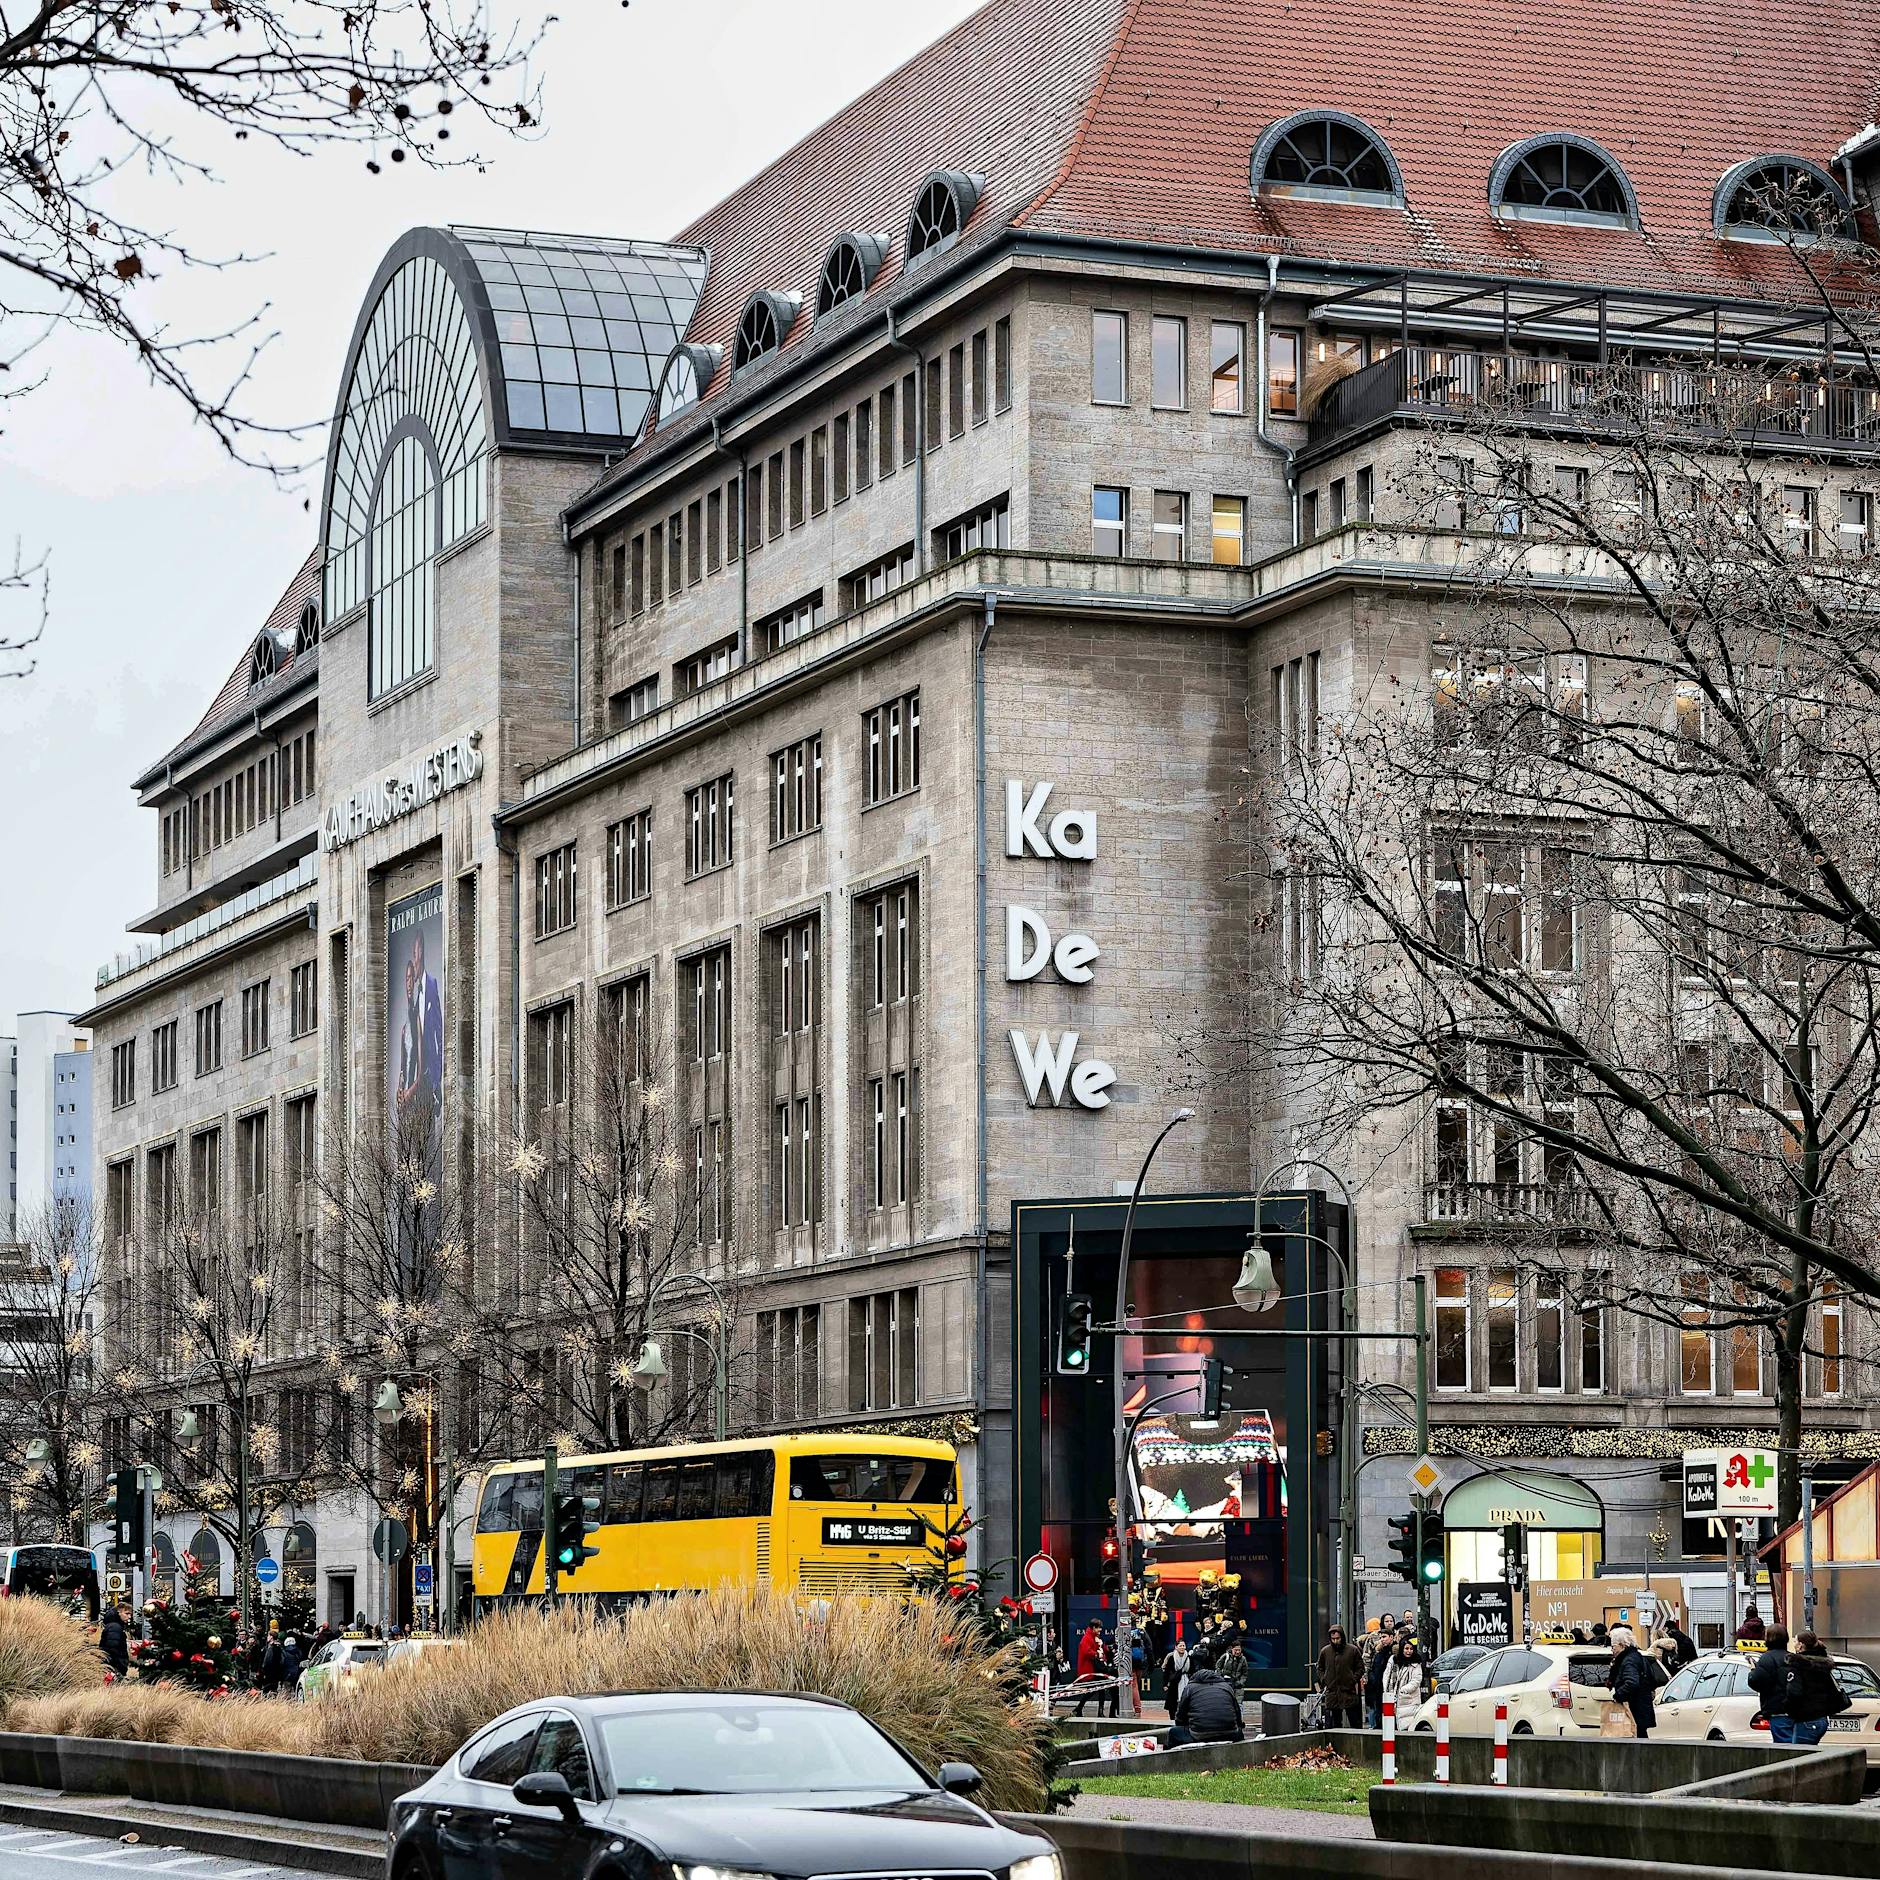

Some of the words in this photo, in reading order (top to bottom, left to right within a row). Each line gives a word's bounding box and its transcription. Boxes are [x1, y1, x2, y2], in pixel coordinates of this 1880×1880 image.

[320, 776, 399, 852] KAUFHAUS
[394, 782, 413, 817] DES
[411, 730, 483, 809] WESTENS
[1006, 779, 1098, 861] Ka
[391, 907, 415, 934] RALPH
[418, 896, 443, 922] LAURE
[1006, 903, 1101, 984] De
[1007, 1029, 1118, 1110] We
[1687, 1485, 1715, 1503] KaDeWe
[1738, 1495, 1751, 1503] 100
[1489, 1509, 1547, 1522] PRADA
[857, 1525, 866, 1534] U
[868, 1525, 912, 1536] Britz-Süd
[416, 1585, 431, 1593] TAXI
[1536, 1584, 1552, 1597] Hier
[1553, 1584, 1585, 1597] entsteht
[1463, 1612, 1508, 1635] KaDeWe
[1463, 1635, 1476, 1644] DIE
[1476, 1635, 1509, 1644] SECHSTE
[1839, 1720, 1859, 1729] 5298
